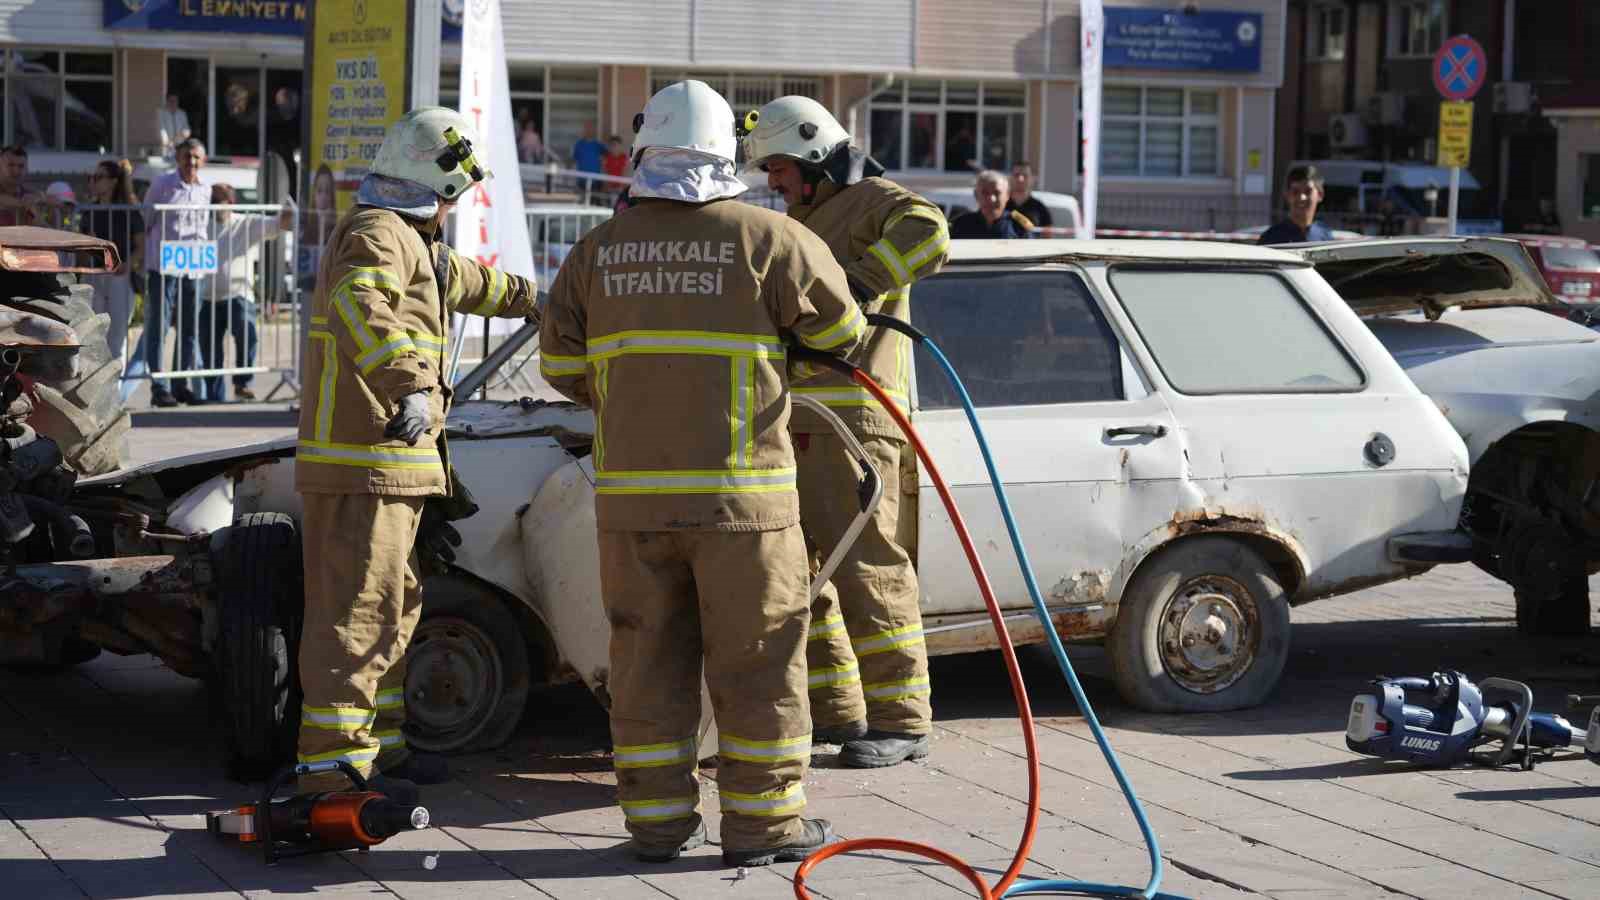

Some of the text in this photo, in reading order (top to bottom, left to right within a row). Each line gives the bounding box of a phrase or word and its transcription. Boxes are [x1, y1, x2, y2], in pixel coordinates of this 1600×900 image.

[336, 55, 378, 80] YKS DİL
[162, 244, 216, 270] POLİS
[596, 240, 737, 267] KIRIKKALE
[602, 266, 724, 297] İTFAİYESİ
[1400, 736, 1441, 751] LUKAS
